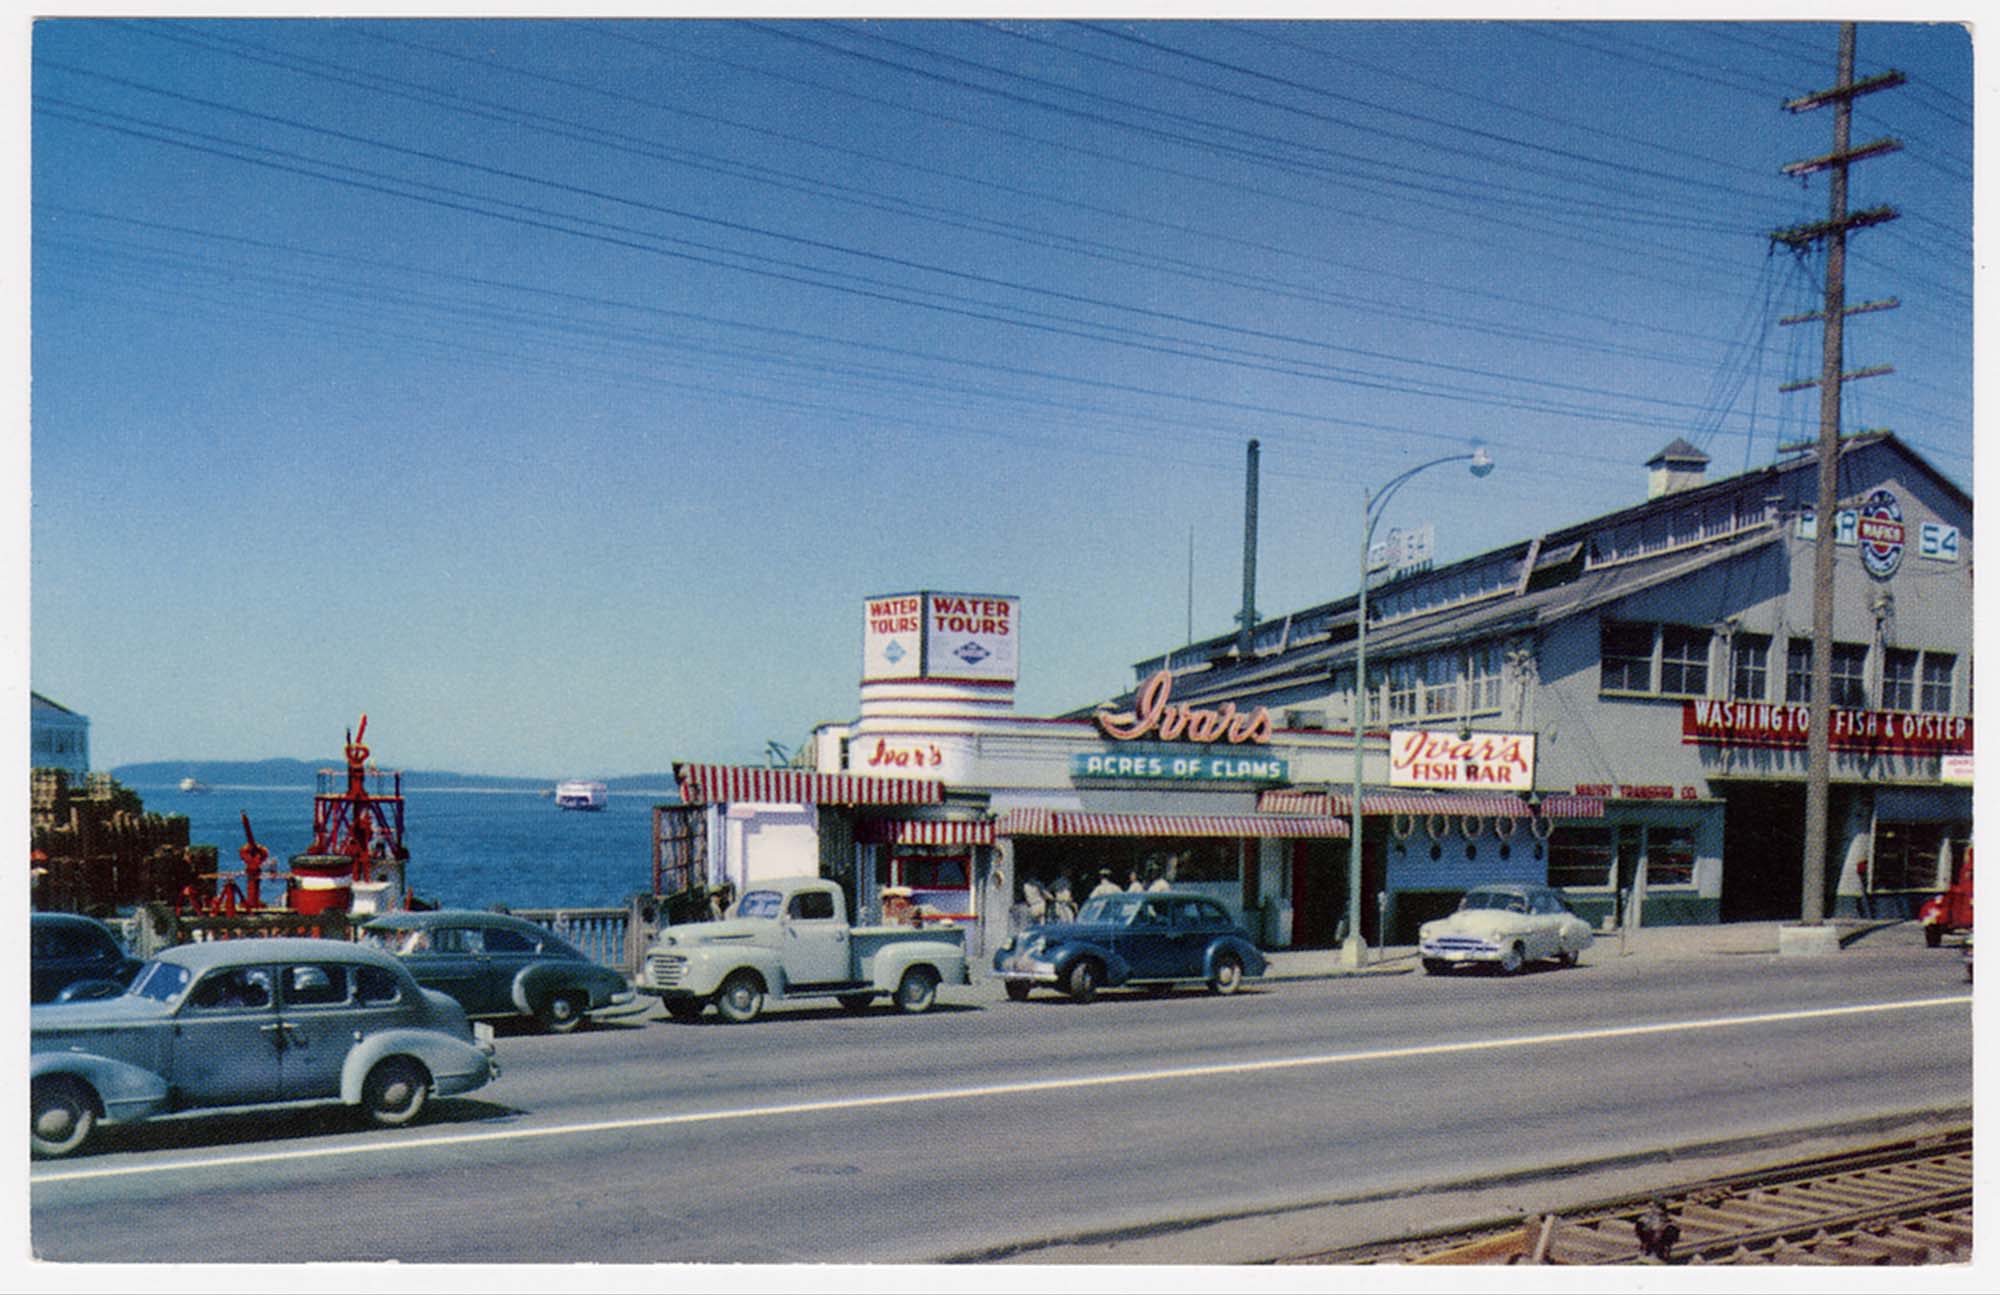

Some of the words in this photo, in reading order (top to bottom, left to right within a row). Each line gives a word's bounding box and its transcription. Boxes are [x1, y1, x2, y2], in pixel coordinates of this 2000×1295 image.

[1800, 511, 1858, 541] PR
[1923, 524, 1957, 555] 54
[869, 599, 918, 617] WATER
[932, 597, 1010, 618] WATER
[870, 617, 918, 634] TOURS
[934, 615, 1010, 636] TOURS
[1694, 700, 1810, 732] WASHINGTO
[1836, 712, 1877, 736] FISH
[1884, 714, 1896, 738] &
[1902, 715, 1967, 740] OYSTER
[868, 737, 943, 767] Ivar's
[1394, 731, 1528, 774] Ivar's
[1087, 756, 1162, 775] ACRES
[1173, 758, 1202, 775] OF
[1211, 759, 1281, 778] CLAMS
[1411, 761, 1458, 781] FISH
[1466, 762, 1512, 783] BAR
